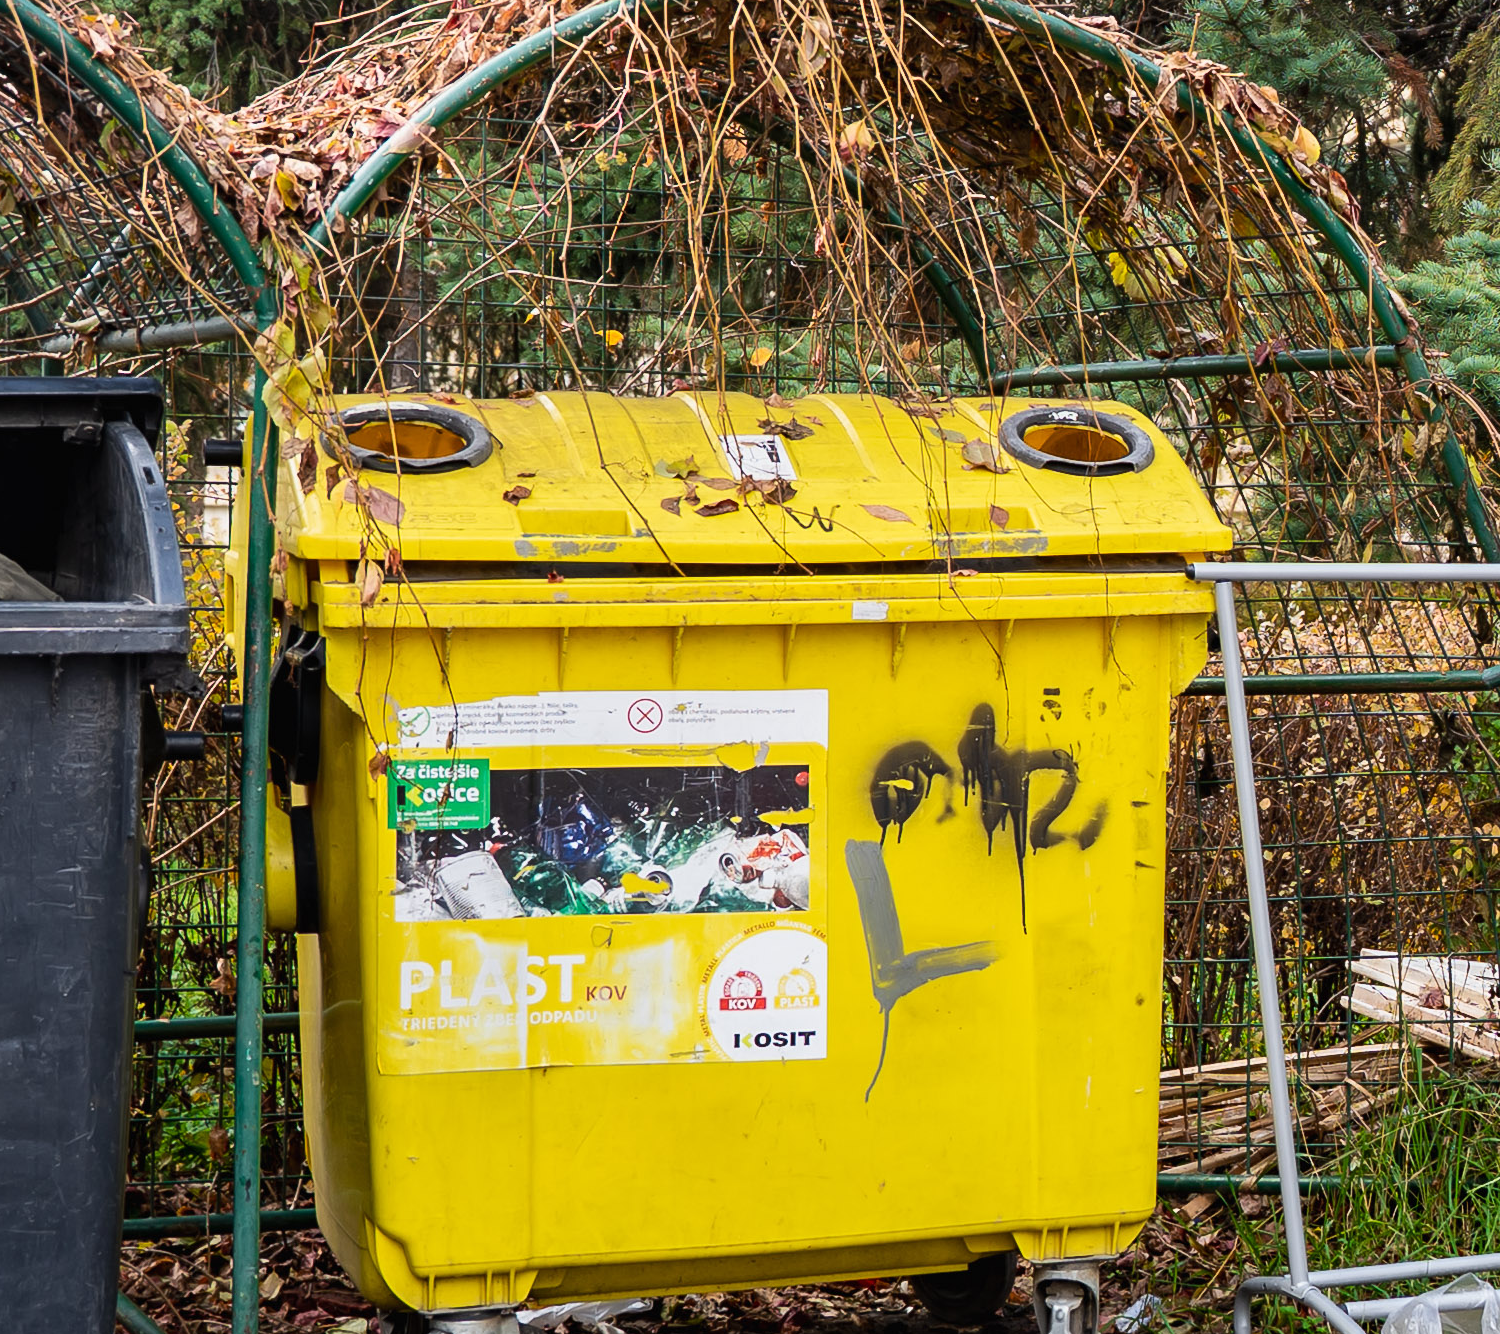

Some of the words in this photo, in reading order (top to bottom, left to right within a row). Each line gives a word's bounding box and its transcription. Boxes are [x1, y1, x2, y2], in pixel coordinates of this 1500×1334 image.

[396, 765, 415, 779] Za
[418, 764, 480, 782] čistejšie
[400, 953, 586, 1010] PLAST
[586, 985, 628, 1002] KOV
[728, 998, 757, 1010] KOV
[779, 996, 816, 1008] PLAST
[529, 1009, 599, 1025] ODPADU
[733, 1030, 817, 1048] KOSIT
